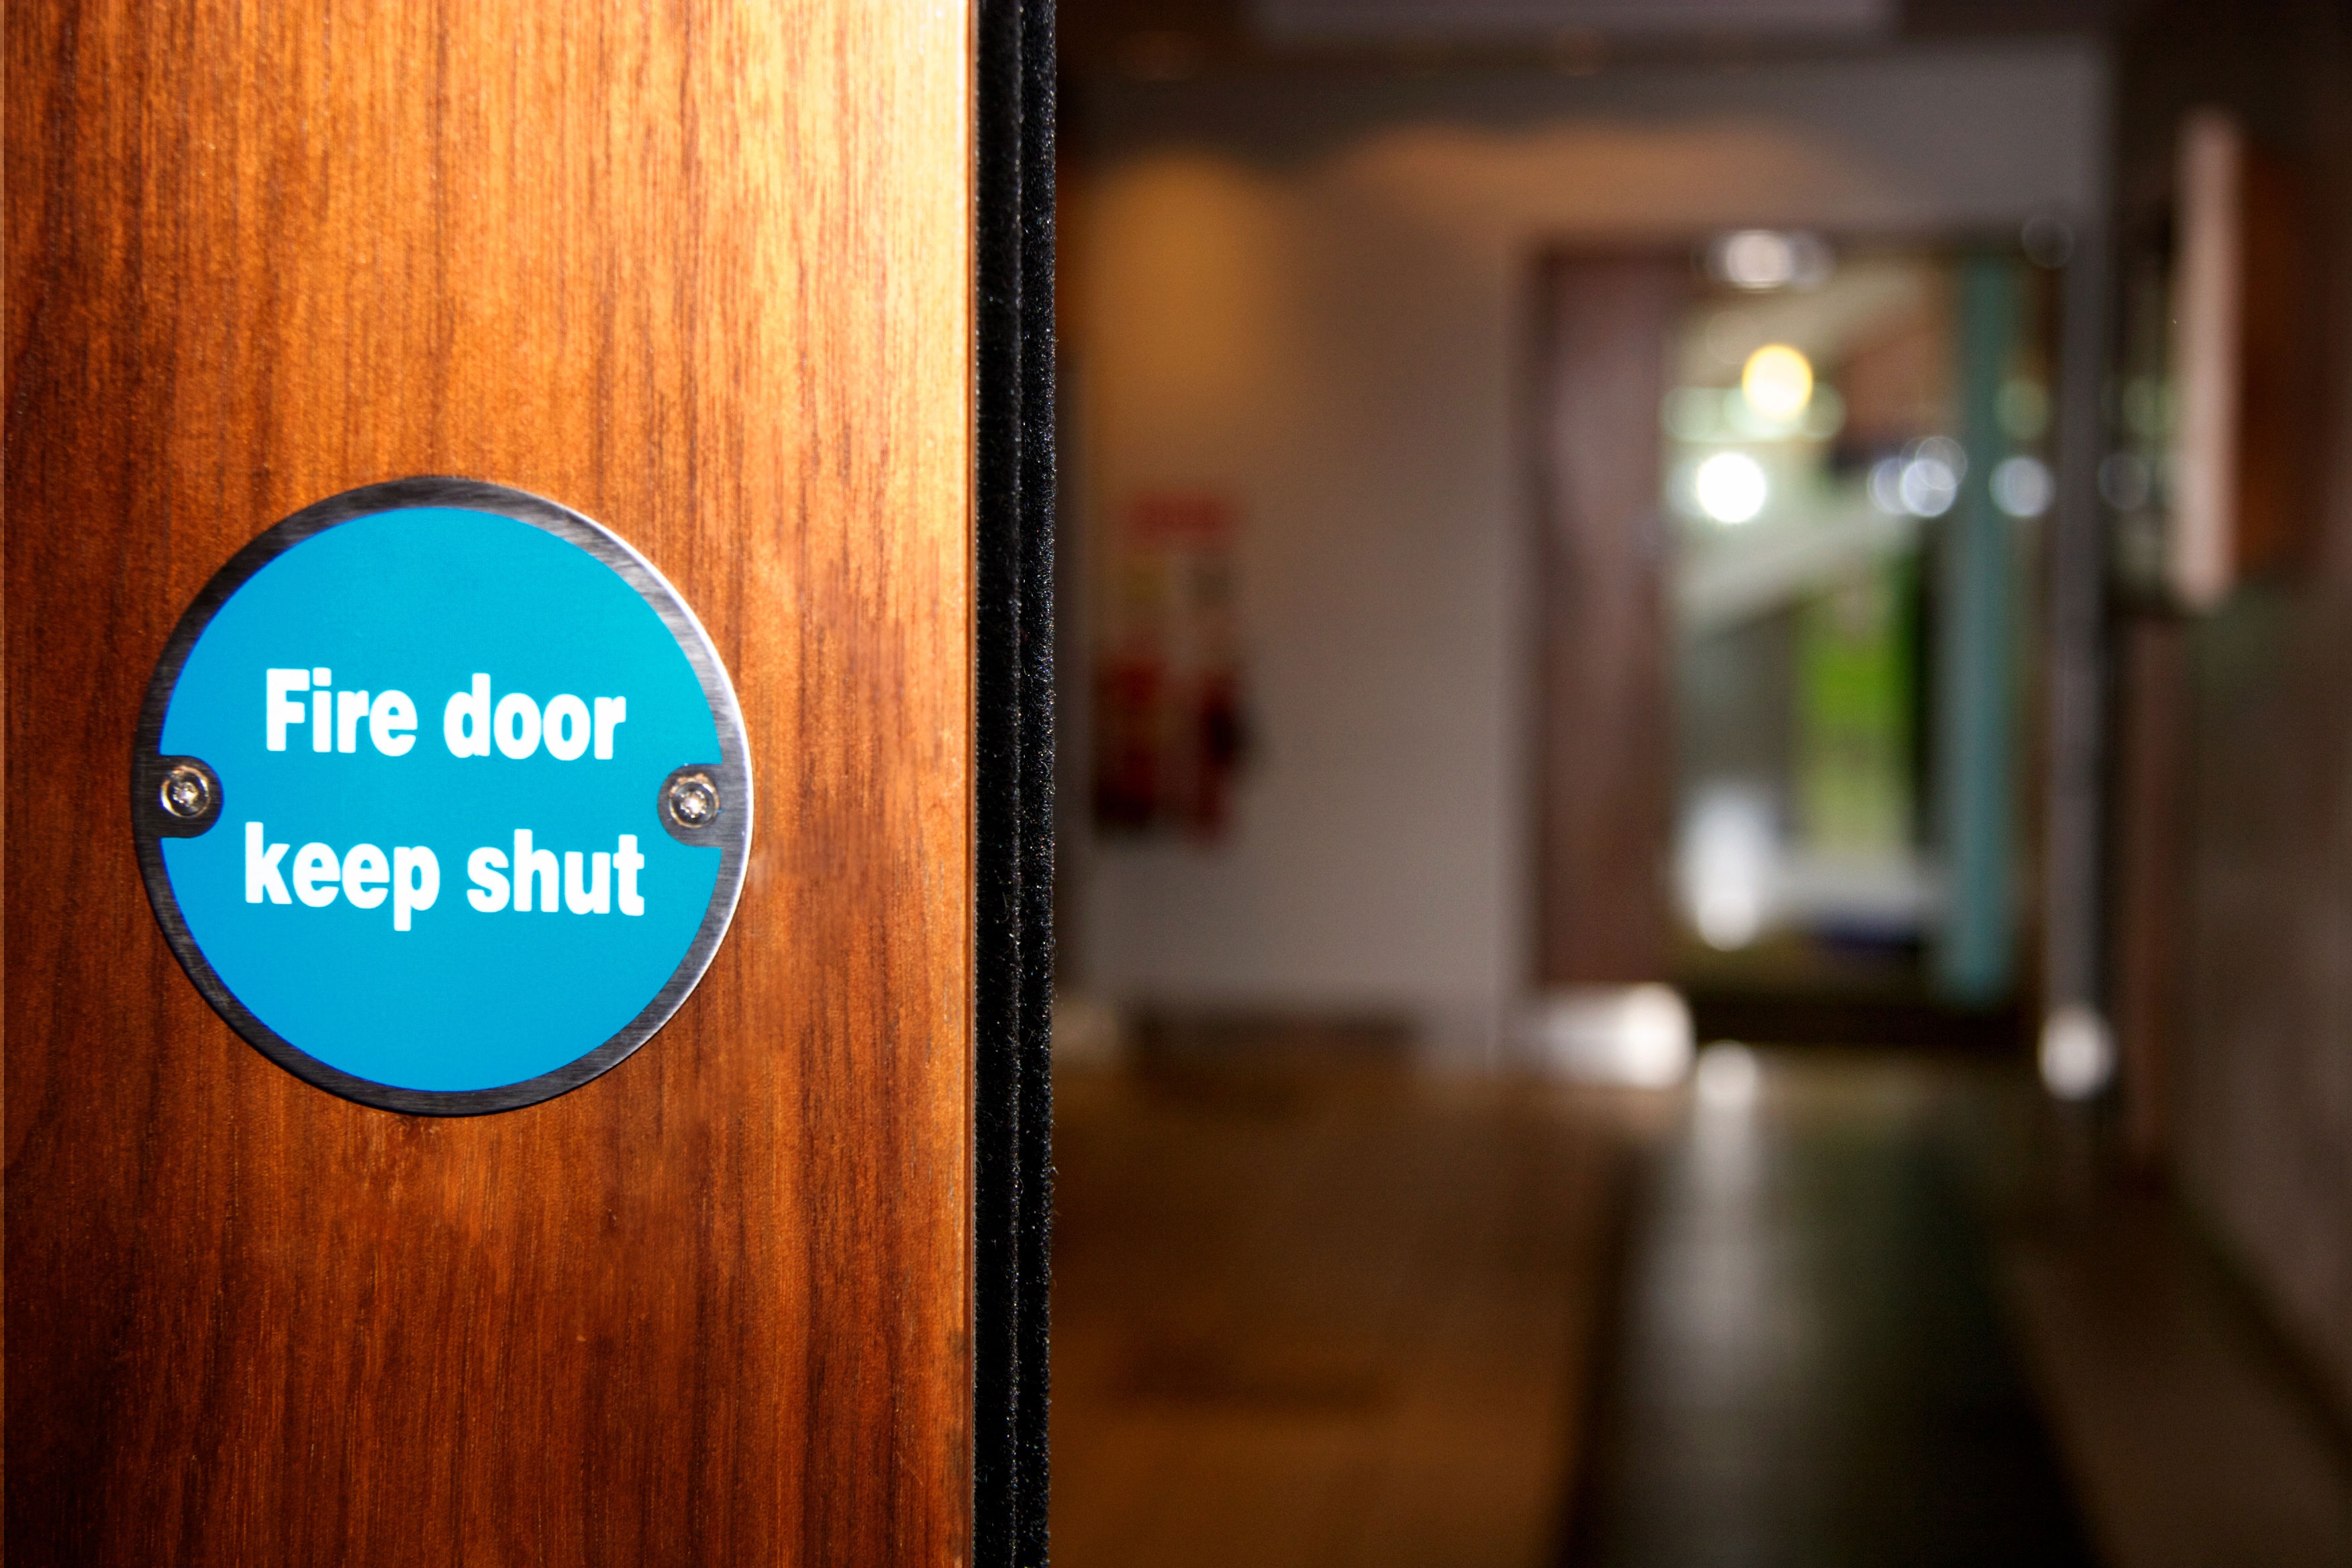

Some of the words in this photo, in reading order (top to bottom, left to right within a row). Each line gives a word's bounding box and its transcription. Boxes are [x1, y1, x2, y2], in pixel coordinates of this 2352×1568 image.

[266, 667, 418, 757] Fire
[443, 673, 626, 761] door
[245, 821, 440, 932] keep
[467, 828, 645, 916] shut
